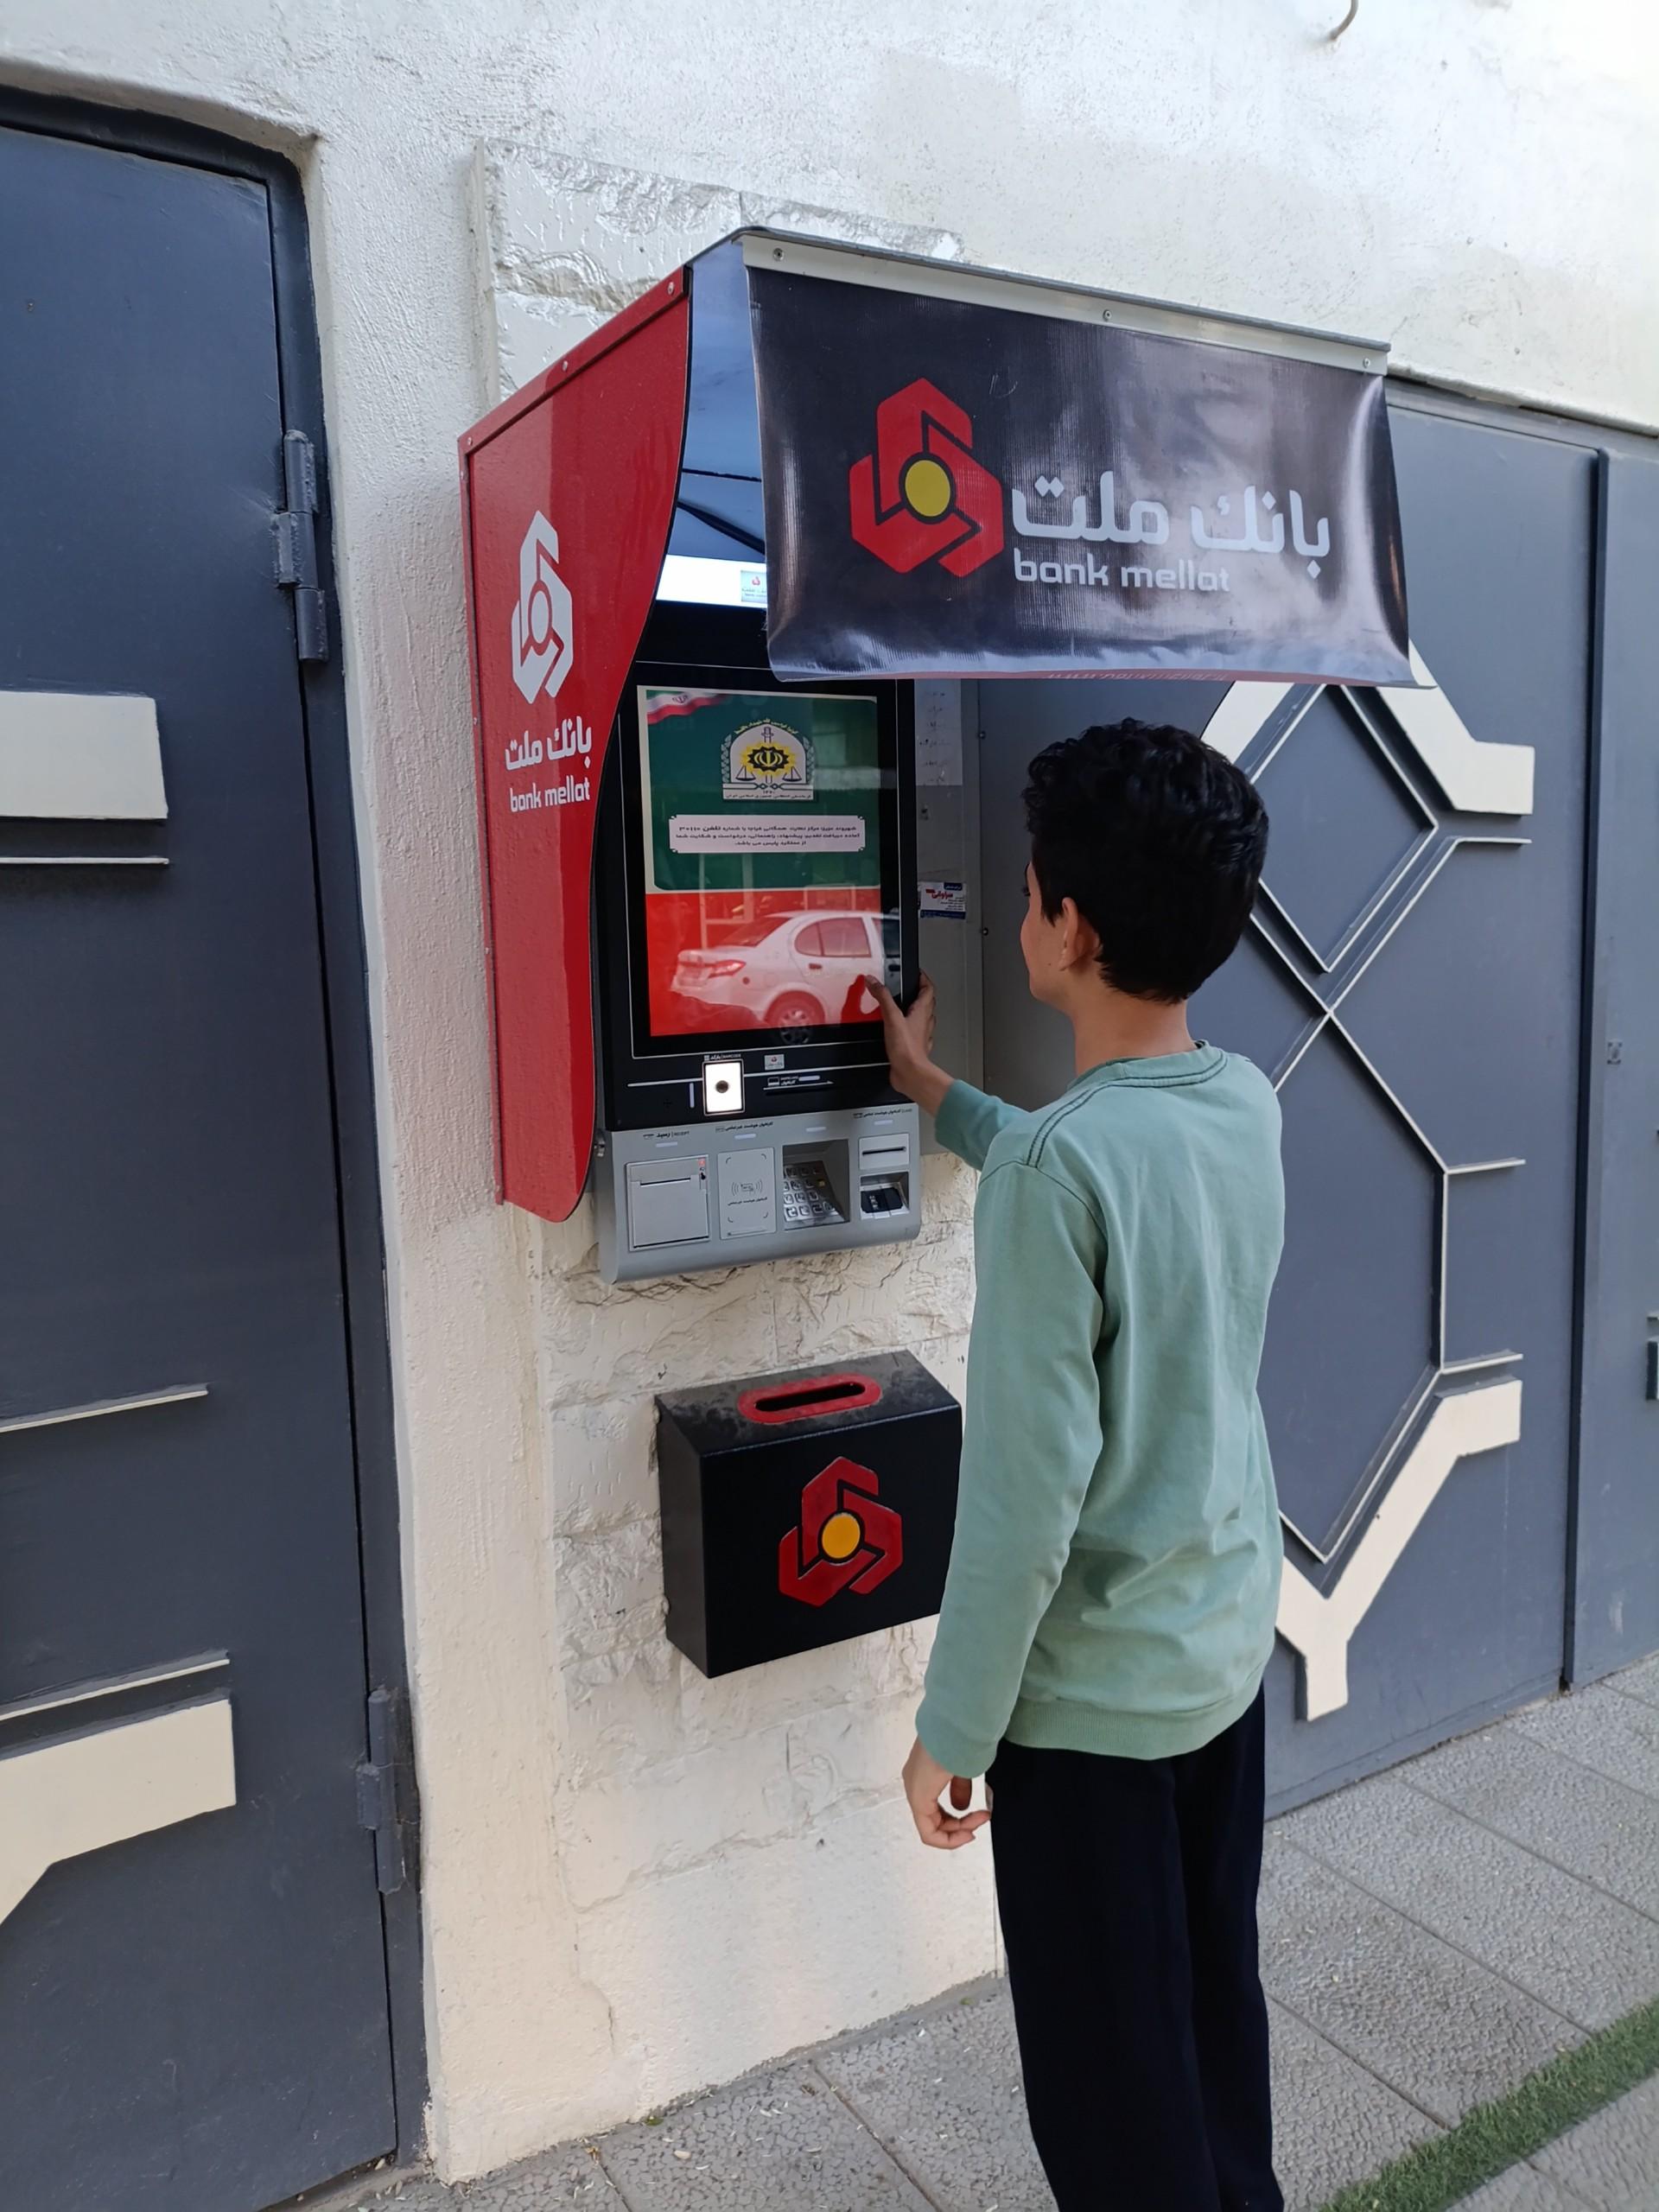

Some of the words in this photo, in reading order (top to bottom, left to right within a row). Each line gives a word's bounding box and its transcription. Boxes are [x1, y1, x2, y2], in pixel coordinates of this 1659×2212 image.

[1011, 470, 1170, 546] ملت
[1013, 547, 1109, 587] bank
[1121, 559, 1230, 593] mellat
[505, 731, 543, 770] ملت
[509, 782, 542, 813] bank
[544, 774, 590, 807] mellat
